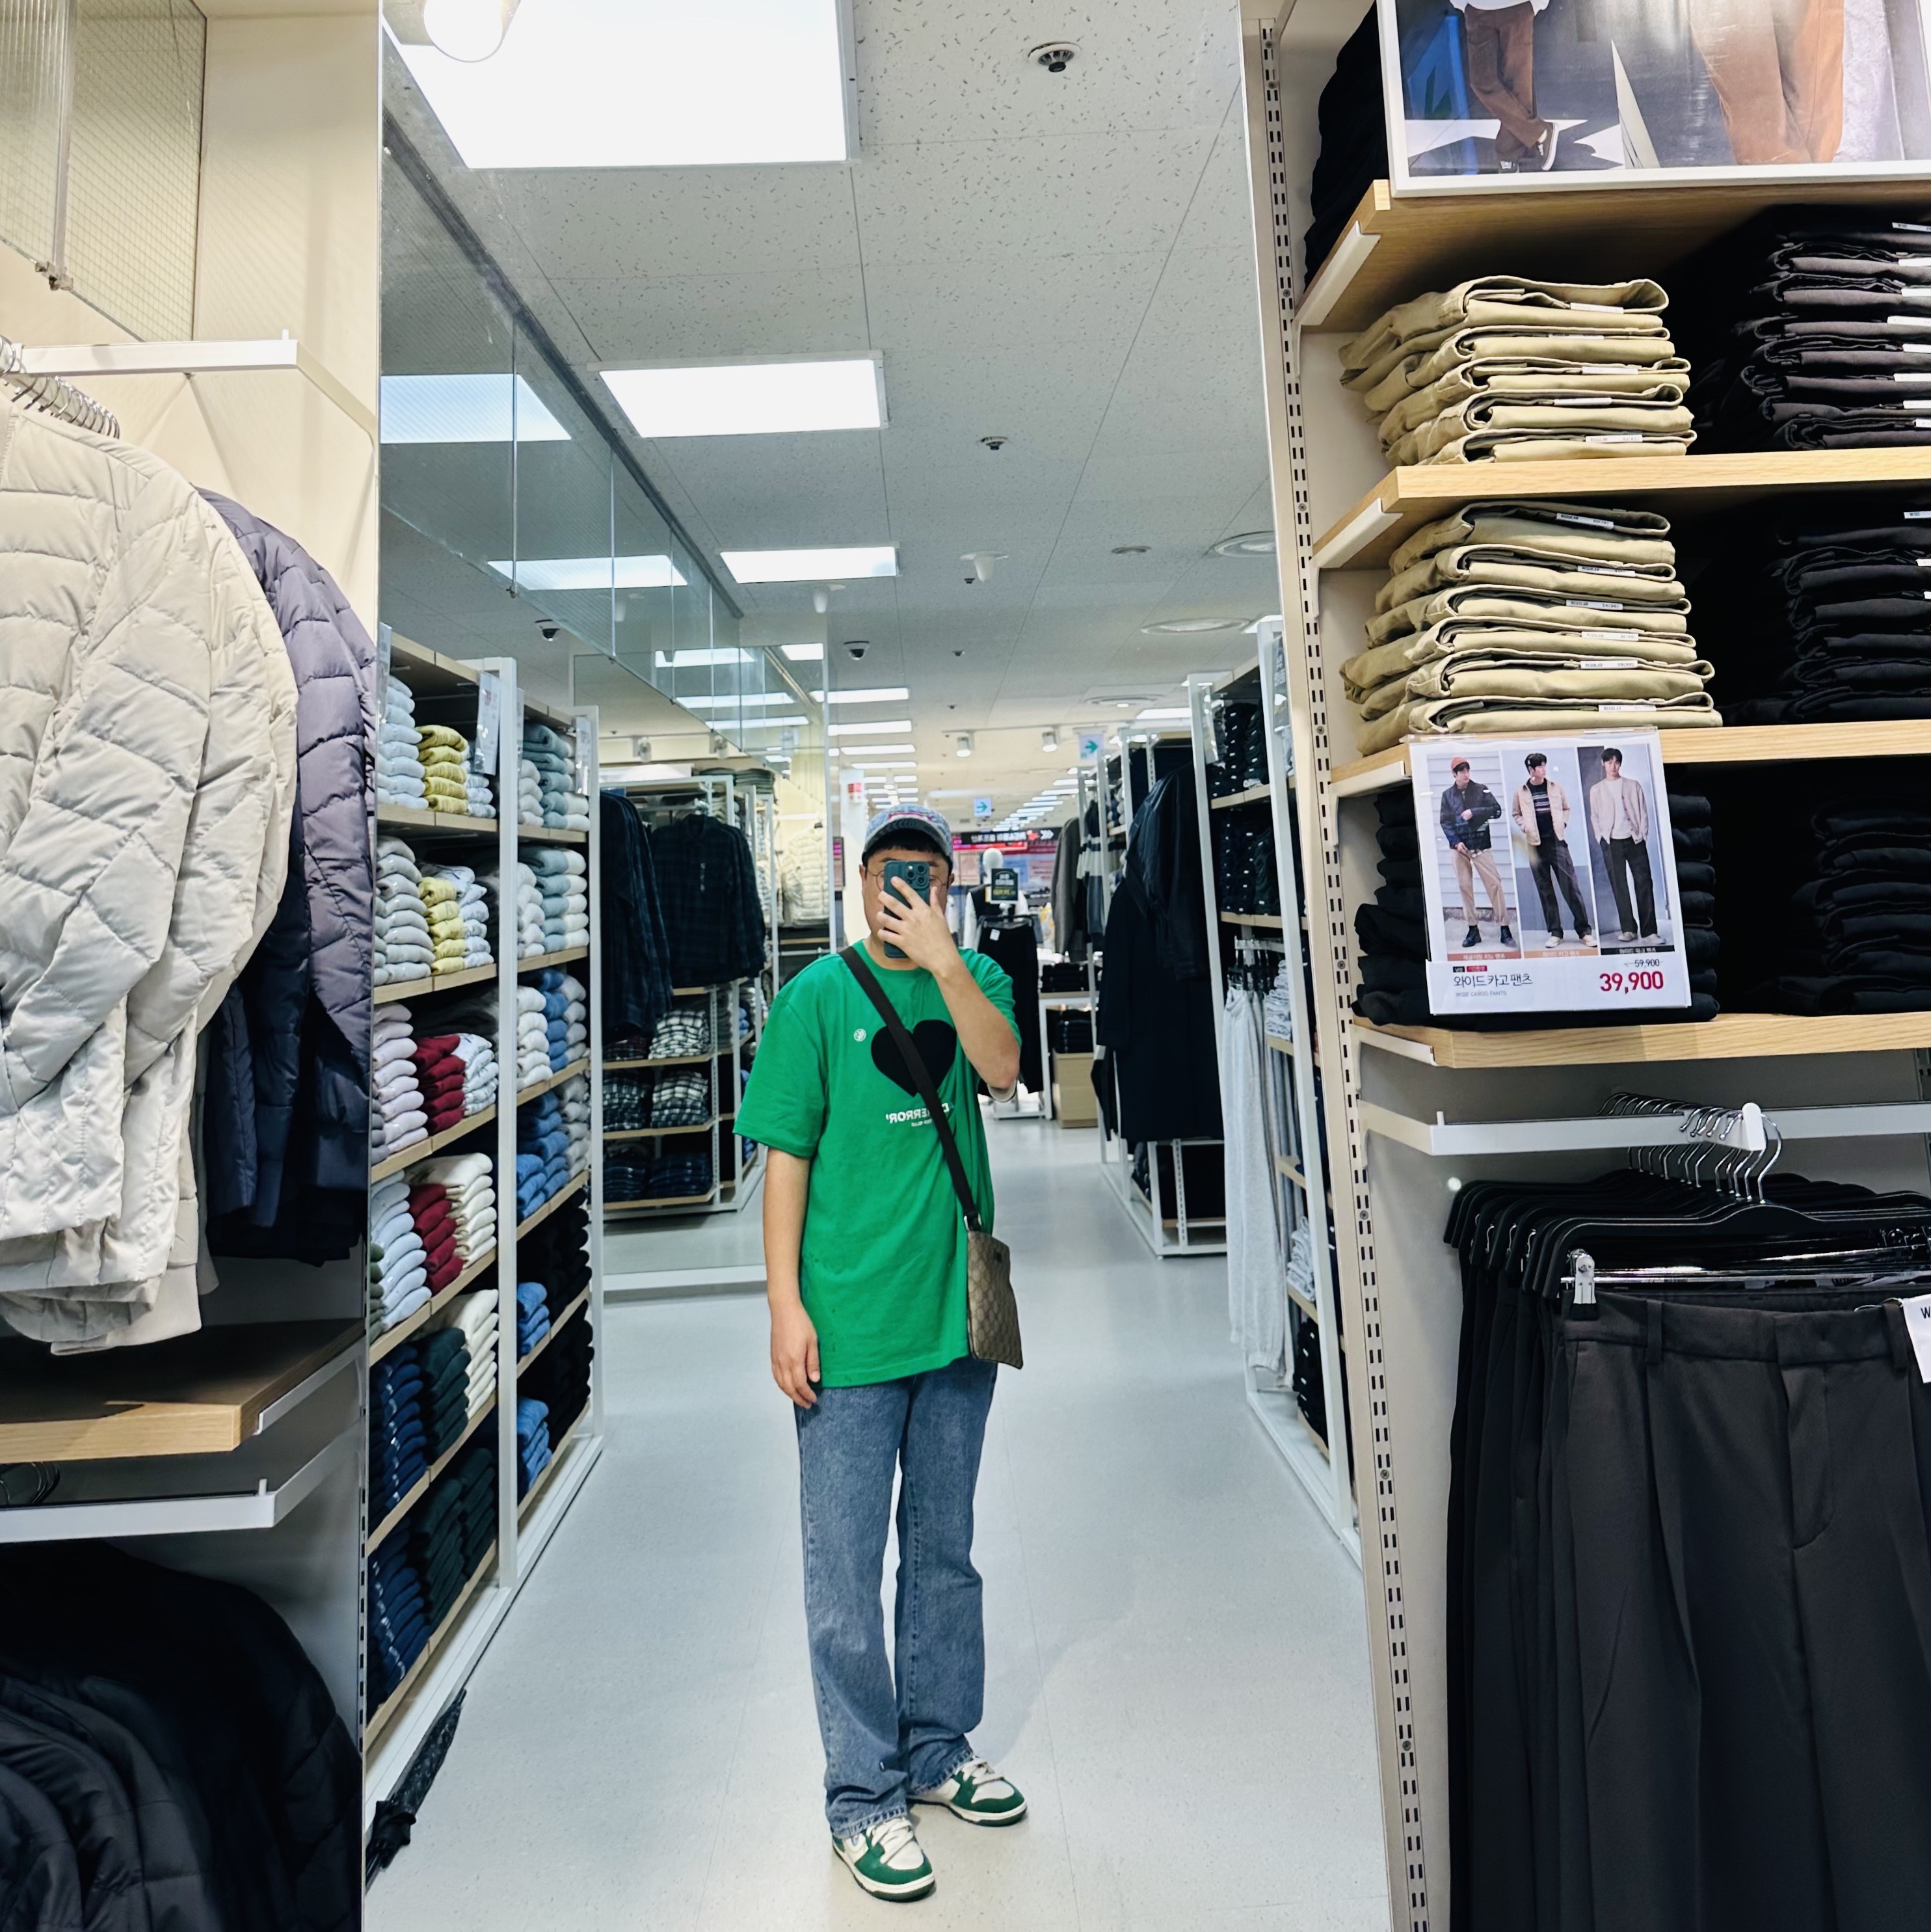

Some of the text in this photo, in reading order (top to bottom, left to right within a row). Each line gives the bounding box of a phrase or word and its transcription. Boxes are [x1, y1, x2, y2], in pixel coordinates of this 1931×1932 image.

[1634, 958, 1660, 969] 59,900
[1454, 973, 1533, 988] 와이드 카고 팬츠
[1599, 971, 1664, 995] 39,900
